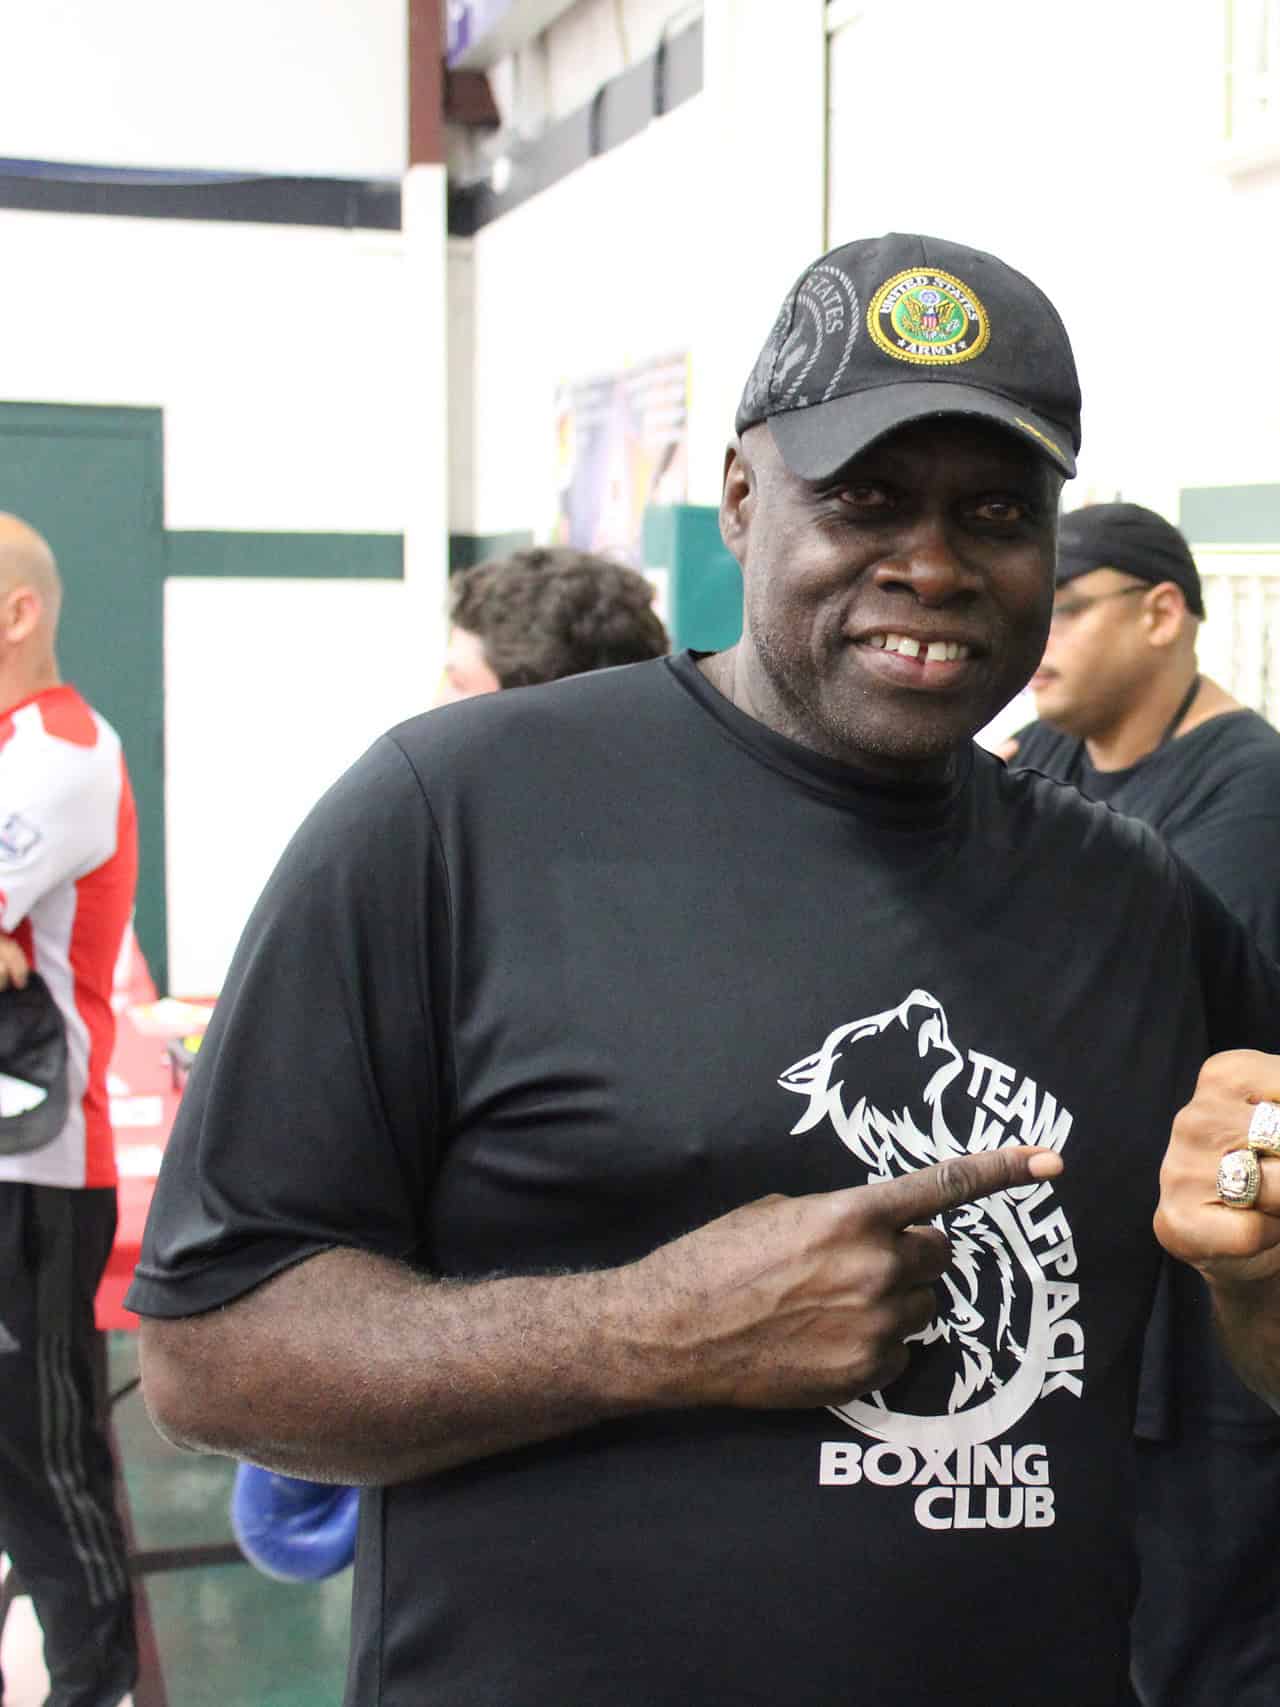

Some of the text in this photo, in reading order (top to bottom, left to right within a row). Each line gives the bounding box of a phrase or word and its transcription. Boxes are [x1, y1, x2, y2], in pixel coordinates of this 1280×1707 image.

[880, 276, 979, 321] UNITED STATES
[904, 342, 958, 355] ARMY
[967, 1048, 1074, 1155] TEAM
[819, 1441, 1050, 1486] BOXING
[914, 1486, 1056, 1530] CLUB
